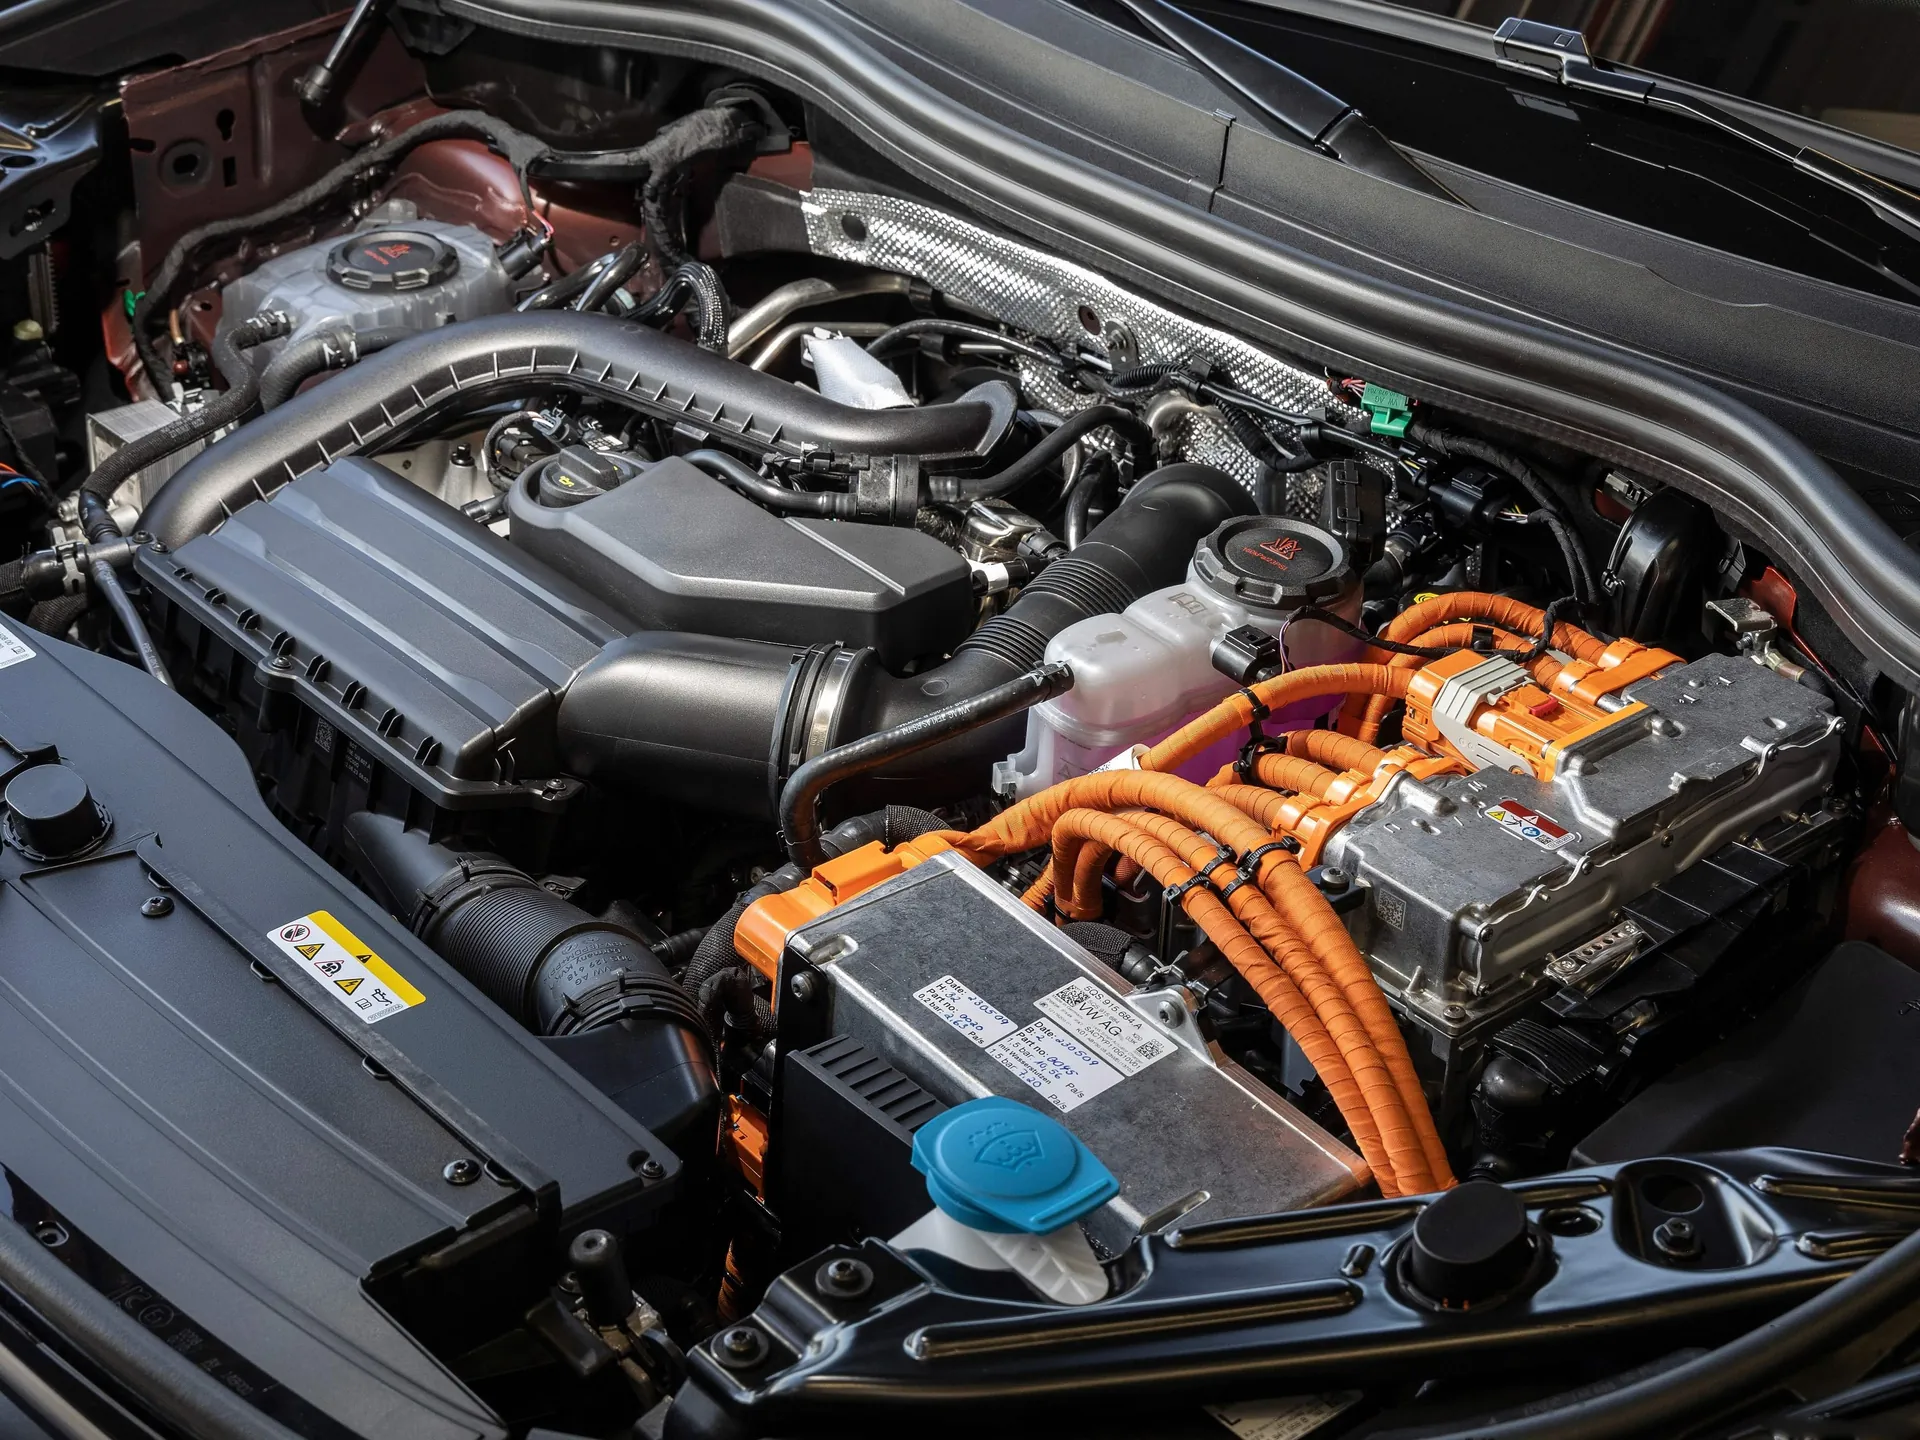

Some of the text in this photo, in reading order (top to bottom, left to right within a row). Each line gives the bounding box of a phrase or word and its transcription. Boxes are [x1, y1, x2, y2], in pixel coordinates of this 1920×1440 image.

[574, 973, 588, 985] AG
[936, 983, 947, 992] H:
[926, 988, 944, 1002] Part
[943, 1001, 958, 1013] no:
[945, 978, 1009, 1025] Date: 230509
[1080, 1002, 1104, 1020] VW
[1100, 1020, 1122, 1036] AG
[968, 1031, 984, 1045] Pa/s
[1025, 1026, 1036, 1036] B:
[998, 1043, 1010, 1053] mit
[1016, 1032, 1035, 1047] Part
[1034, 1046, 1048, 1057] no:
[1034, 1021, 1057, 1039] Date:
[1055, 1039, 1099, 1066] 230509
[1065, 1082, 1085, 1099] Pa/s
[1047, 1093, 1068, 1110] Pa/s
